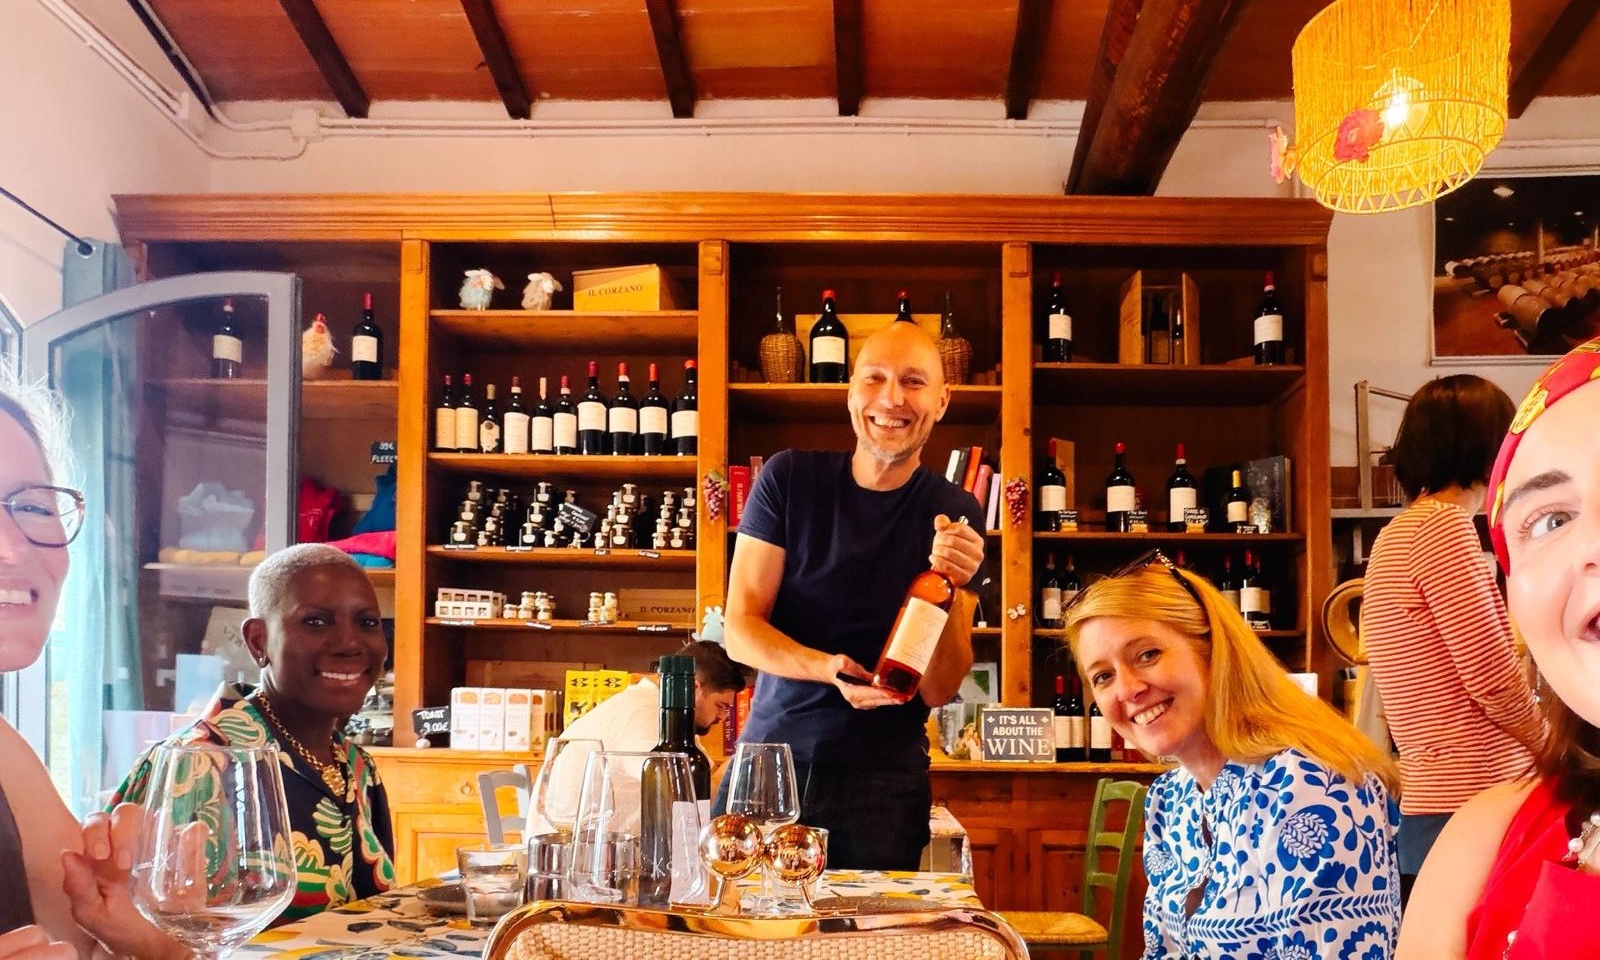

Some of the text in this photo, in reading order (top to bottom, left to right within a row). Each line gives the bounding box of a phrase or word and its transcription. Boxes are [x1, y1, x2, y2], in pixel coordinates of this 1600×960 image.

[588, 284, 643, 297] IL CORZANO
[371, 454, 398, 463] FLEEC
[640, 605, 696, 614] IL CORZANO
[416, 709, 445, 720] TOAST
[999, 715, 1037, 725] IT'S ALL
[992, 726, 1044, 736] ABOUT THE
[986, 738, 1051, 756] WINE
